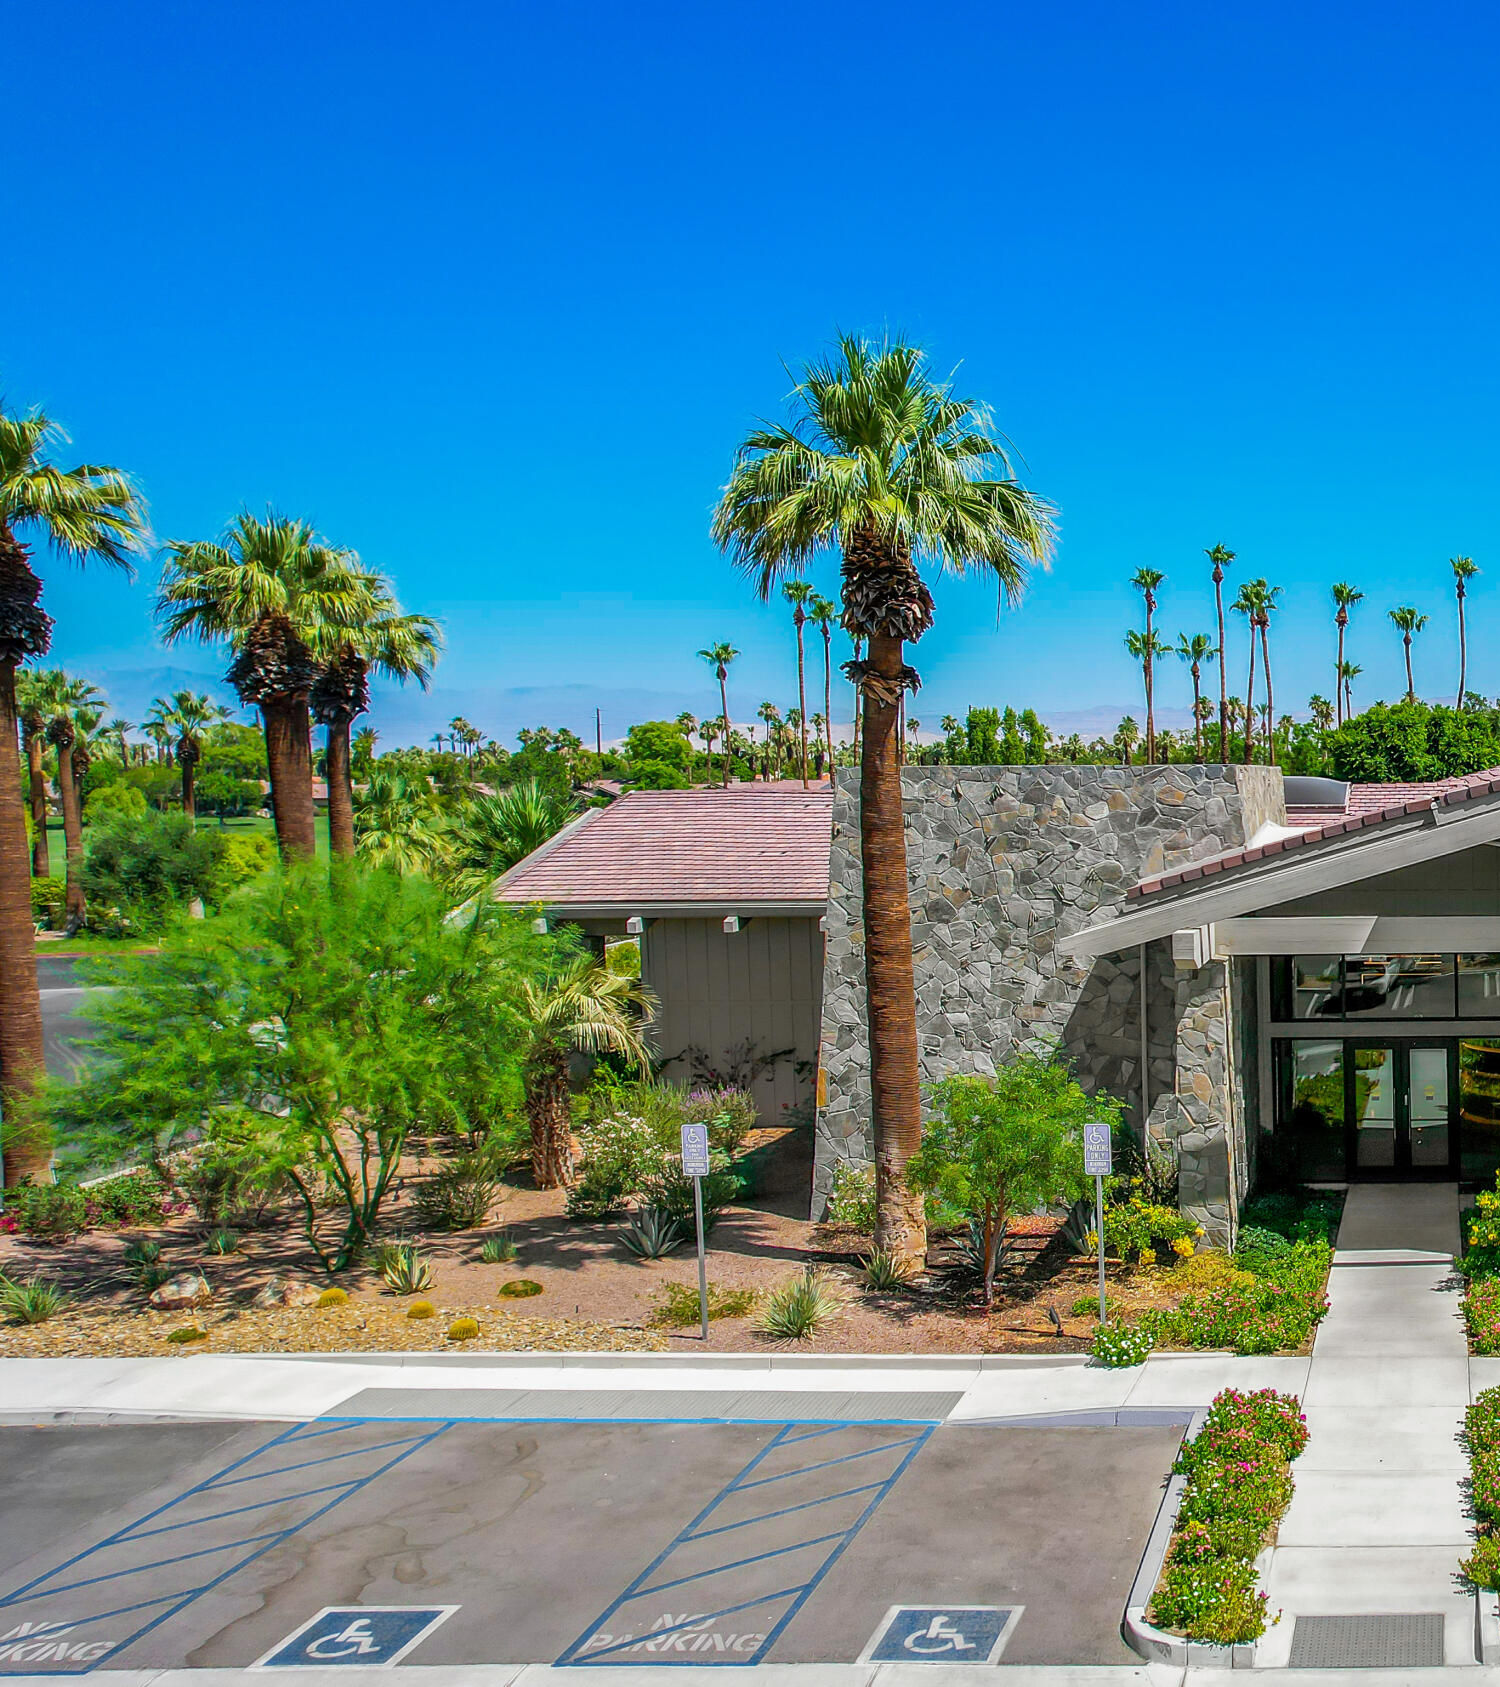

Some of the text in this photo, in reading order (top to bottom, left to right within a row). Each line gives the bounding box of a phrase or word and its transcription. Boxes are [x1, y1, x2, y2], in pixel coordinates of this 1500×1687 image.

[1086, 1144, 1109, 1152] PARKING
[1090, 1152, 1105, 1160] ONLY
[650, 1613, 716, 1631] NO
[0, 1641, 117, 1661] KING
[579, 1633, 770, 1652] PARKING
